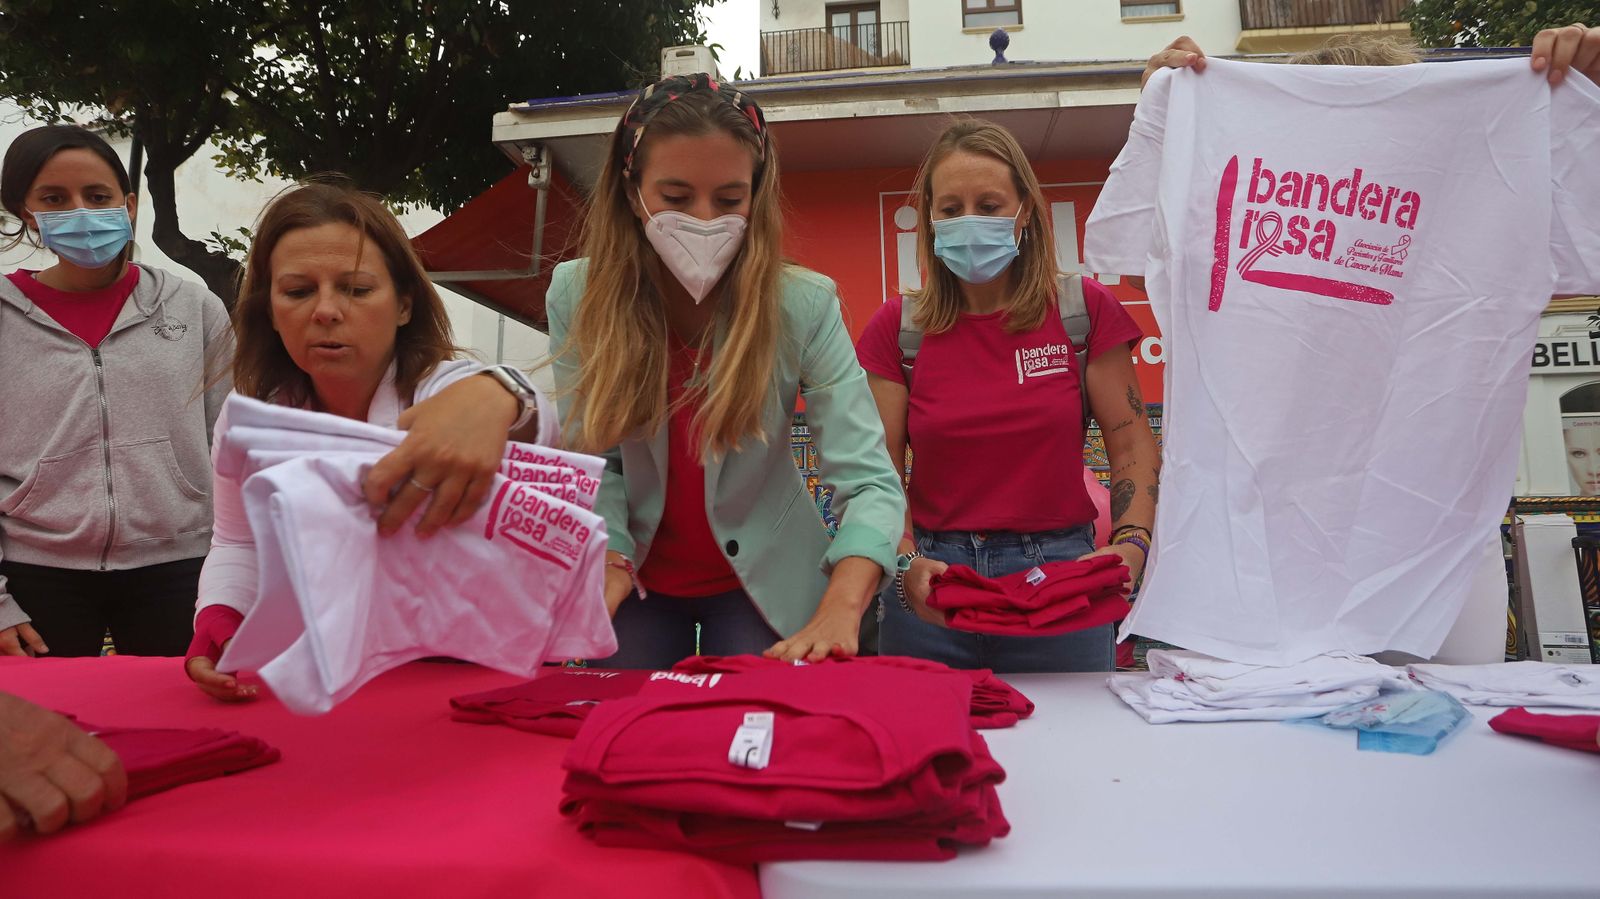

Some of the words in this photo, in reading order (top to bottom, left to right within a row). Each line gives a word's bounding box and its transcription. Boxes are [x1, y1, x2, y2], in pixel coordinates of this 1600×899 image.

[1247, 158, 1421, 230] bandera
[1239, 209, 1336, 262] rosa
[1022, 343, 1068, 360] bandera
[1024, 356, 1049, 371] rosa
[501, 505, 547, 542] rosa
[509, 485, 590, 544] bandera
